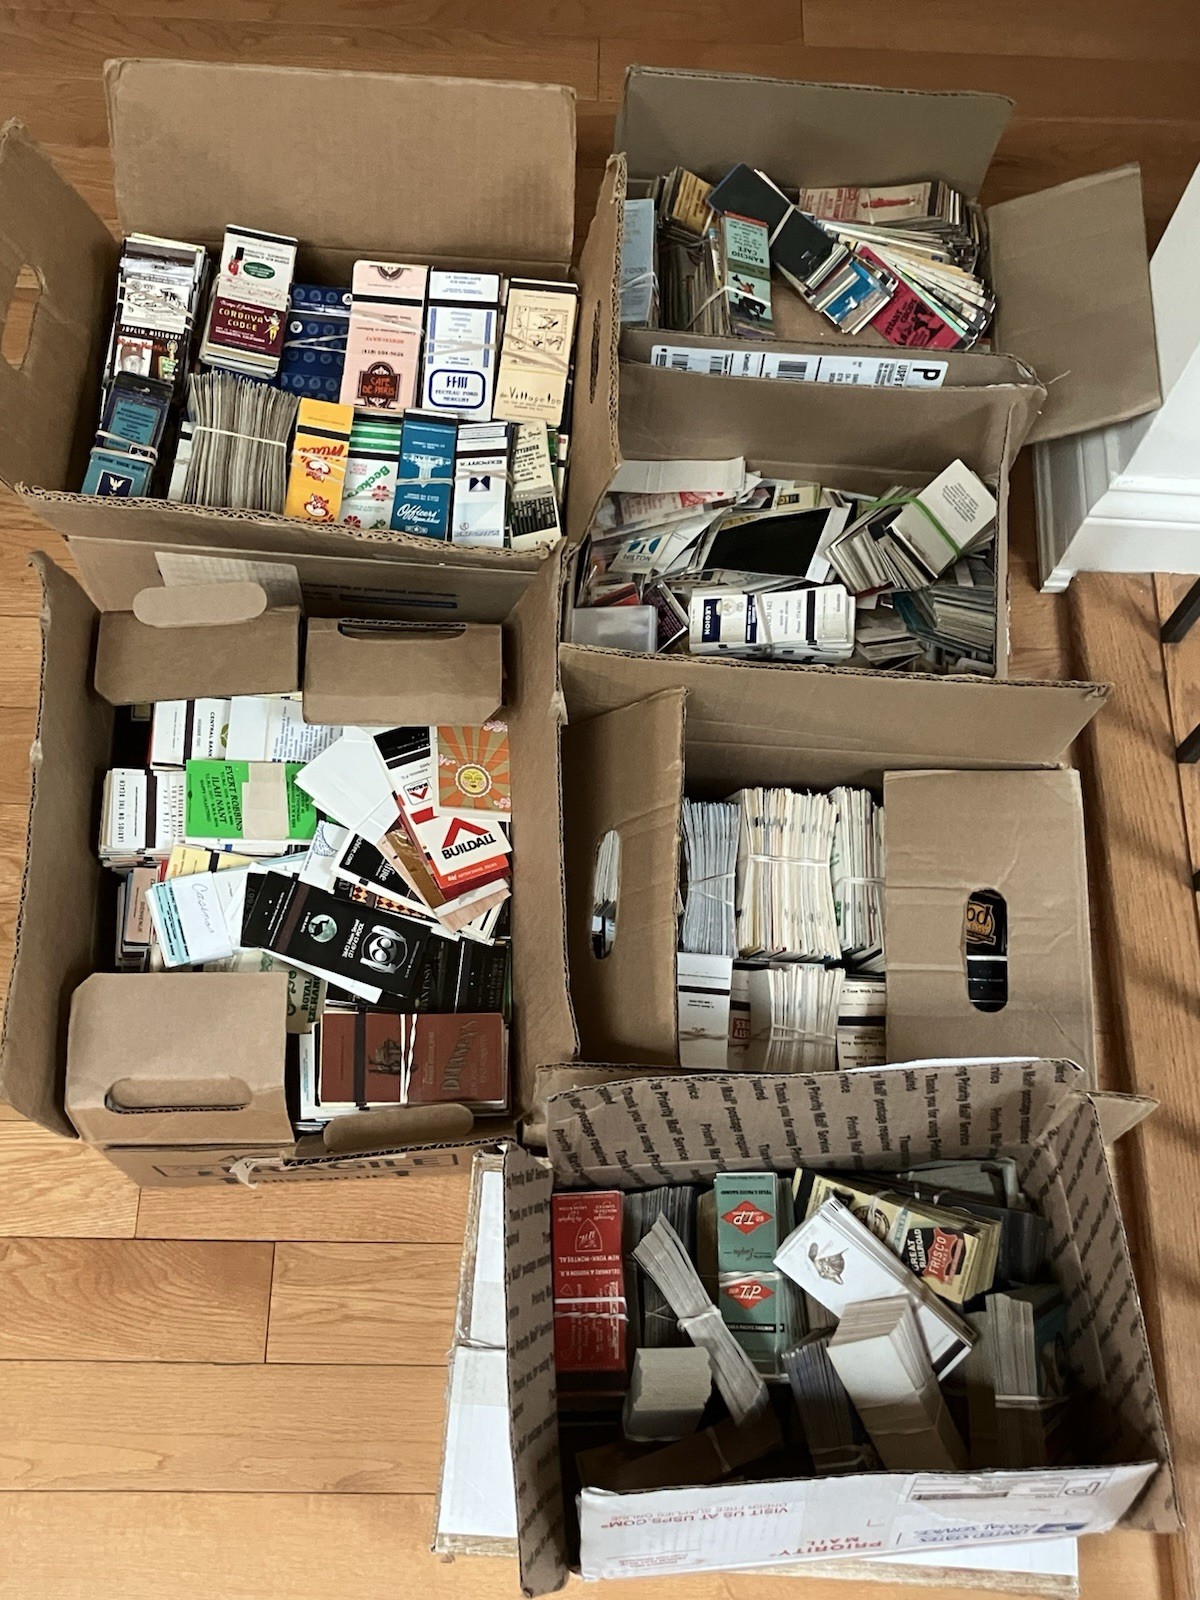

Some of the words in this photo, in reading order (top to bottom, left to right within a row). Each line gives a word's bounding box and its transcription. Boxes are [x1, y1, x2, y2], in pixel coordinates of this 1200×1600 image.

[732, 251, 764, 263] RANCHO
[219, 308, 263, 323] CORDOVA
[228, 319, 258, 332] LODGE
[913, 368, 941, 381] P
[622, 553, 652, 563] HILTON
[703, 606, 712, 636] LEGION
[210, 776, 221, 800] ILAH
[217, 801, 228, 824] NANT
[224, 765, 235, 793] EVERT
[231, 793, 243, 832] ROBBINS
[118, 812, 125, 820] ON
[117, 823, 125, 843] LARIOS
[441, 833, 497, 860] BUILDALL
[301, 978, 313, 1011] ROYAL
[925, 1073, 939, 1094] Thank
[956, 1077, 970, 1102] Priority
[621, 1086, 638, 1109] Thank
[774, 1082, 789, 1104] Thank
[924, 1096, 936, 1107] you
[627, 1110, 642, 1122] you
[724, 1106, 743, 1133] postage
[777, 1105, 791, 1118] you
[807, 1086, 824, 1111] Priority
[817, 1130, 830, 1154] Service
[873, 1099, 887, 1124] postage
[927, 1108, 939, 1118] for
[636, 1123, 647, 1133] for
[655, 1091, 673, 1117] Priority
[673, 1137, 689, 1160] Service
[782, 1118, 794, 1128] for
[846, 1116, 860, 1140] Priority
[927, 1119, 940, 1138] using
[700, 1123, 717, 1146] Priority
[785, 1129, 798, 1147] using
[959, 1121, 970, 1146] Service
[640, 1135, 654, 1152] using
[907, 1239, 920, 1271] GREAT
[914, 1228, 927, 1268] RAILROAD
[929, 1236, 947, 1274] FRISCO
[1064, 1481, 1100, 1495] P
[699, 1512, 719, 1520] AT
[723, 1510, 745, 1518] US
[747, 1507, 788, 1517] VISIT
[807, 1536, 858, 1546] MAIL
[919, 1533, 977, 1543] STATES
[984, 1529, 1030, 1539] UNITED
